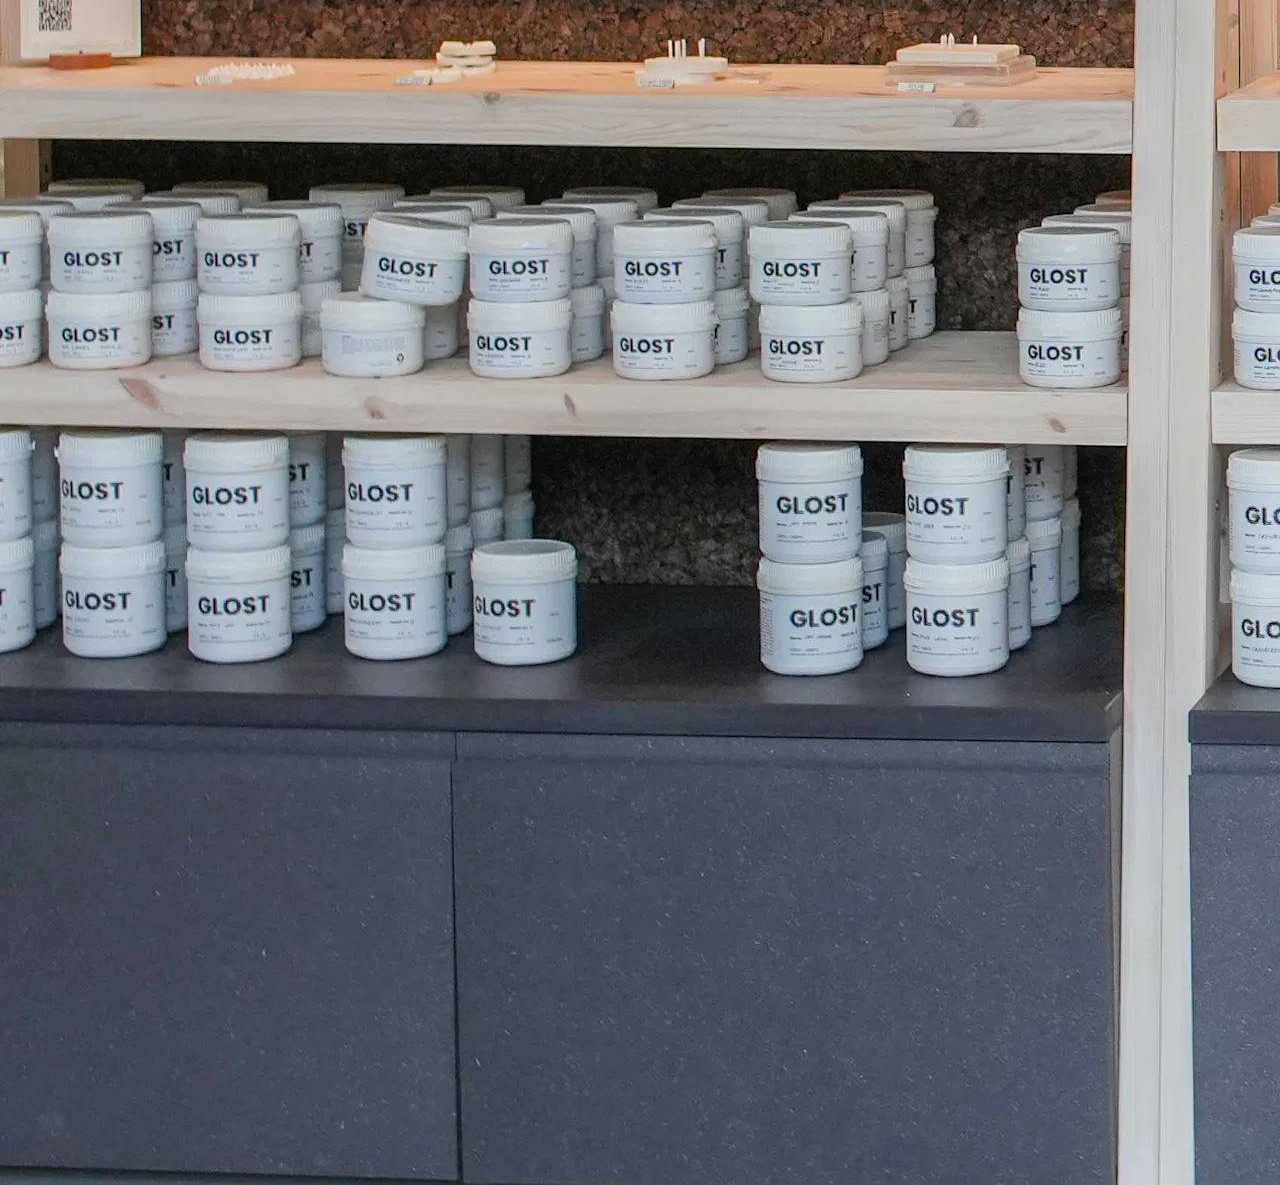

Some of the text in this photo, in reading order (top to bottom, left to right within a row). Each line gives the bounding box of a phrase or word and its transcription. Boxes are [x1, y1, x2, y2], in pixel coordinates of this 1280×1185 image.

[152, 240, 184, 255] OST
[64, 252, 122, 266] GLOST
[205, 252, 259, 267] GLOST
[379, 257, 437, 277] GLOST
[489, 260, 548, 275] GLOST
[625, 261, 682, 276] GLOST
[763, 262, 821, 277] GLOST
[1030, 268, 1087, 284] GLOST
[62, 328, 120, 342] GLOST
[214, 330, 272, 344] GLOST
[477, 335, 531, 351] GLOST
[620, 338, 674, 353] GLOST
[770, 339, 824, 355] GLOST
[1028, 345, 1083, 360] GLOST
[62, 479, 123, 500] GLOST
[193, 486, 261, 505] GLOST
[349, 483, 413, 502] GLOST
[777, 494, 848, 514] GLOST
[908, 494, 968, 515] GLOST
[66, 590, 131, 610] GLOST
[198, 595, 269, 615] GLOST
[349, 592, 415, 611] GLOST
[476, 598, 534, 617] GLOST
[790, 604, 857, 627] GLOST
[911, 607, 979, 627] GLOST
